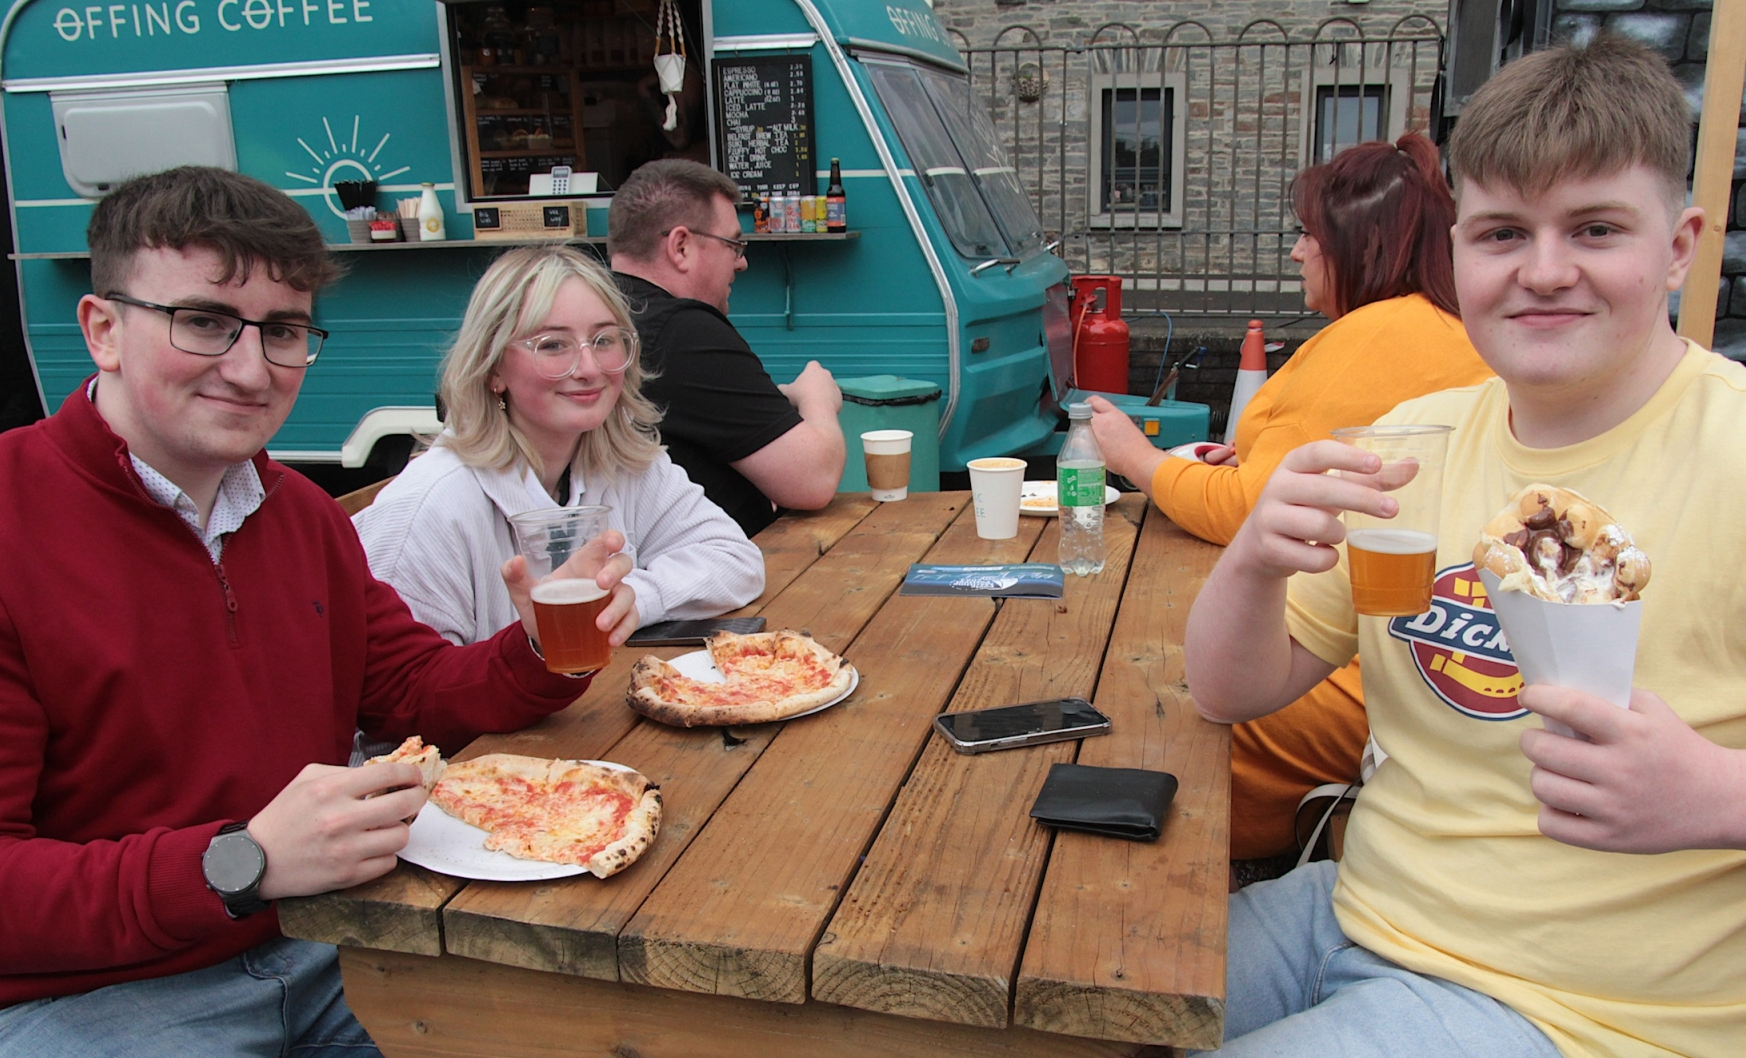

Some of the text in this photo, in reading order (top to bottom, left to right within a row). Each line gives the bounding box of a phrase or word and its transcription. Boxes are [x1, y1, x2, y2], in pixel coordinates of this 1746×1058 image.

[53, 0, 373, 41] OFFING COFFEE
[723, 66, 756, 75] ESPRESSO
[723, 73, 758, 82] AMERICANO
[724, 81, 739, 89] FLAT
[742, 80, 761, 89] WHITE
[724, 88, 763, 97] CAPPUCCINO
[725, 96, 745, 105] LATTE
[725, 104, 741, 112] ICED
[745, 102, 766, 111] LATTE
[725, 111, 749, 119] MOCHA
[726, 119, 741, 127] CHAI
[783, 122, 798, 131] MILK
[727, 132, 751, 141] BELFAST
[756, 132, 771, 140] BREW
[773, 131, 788, 139] TEA
[748, 139, 770, 148] HERBAL
[774, 138, 789, 146] TEA
[755, 146, 766, 155] HOT
[771, 145, 787, 154] CHOC
[728, 155, 745, 163] SOFT
[749, 154, 767, 162] DRINK
[754, 160, 772, 169] JUICE
[742, 170, 763, 179] CREAM
[1405, 604, 1511, 653] Dick
